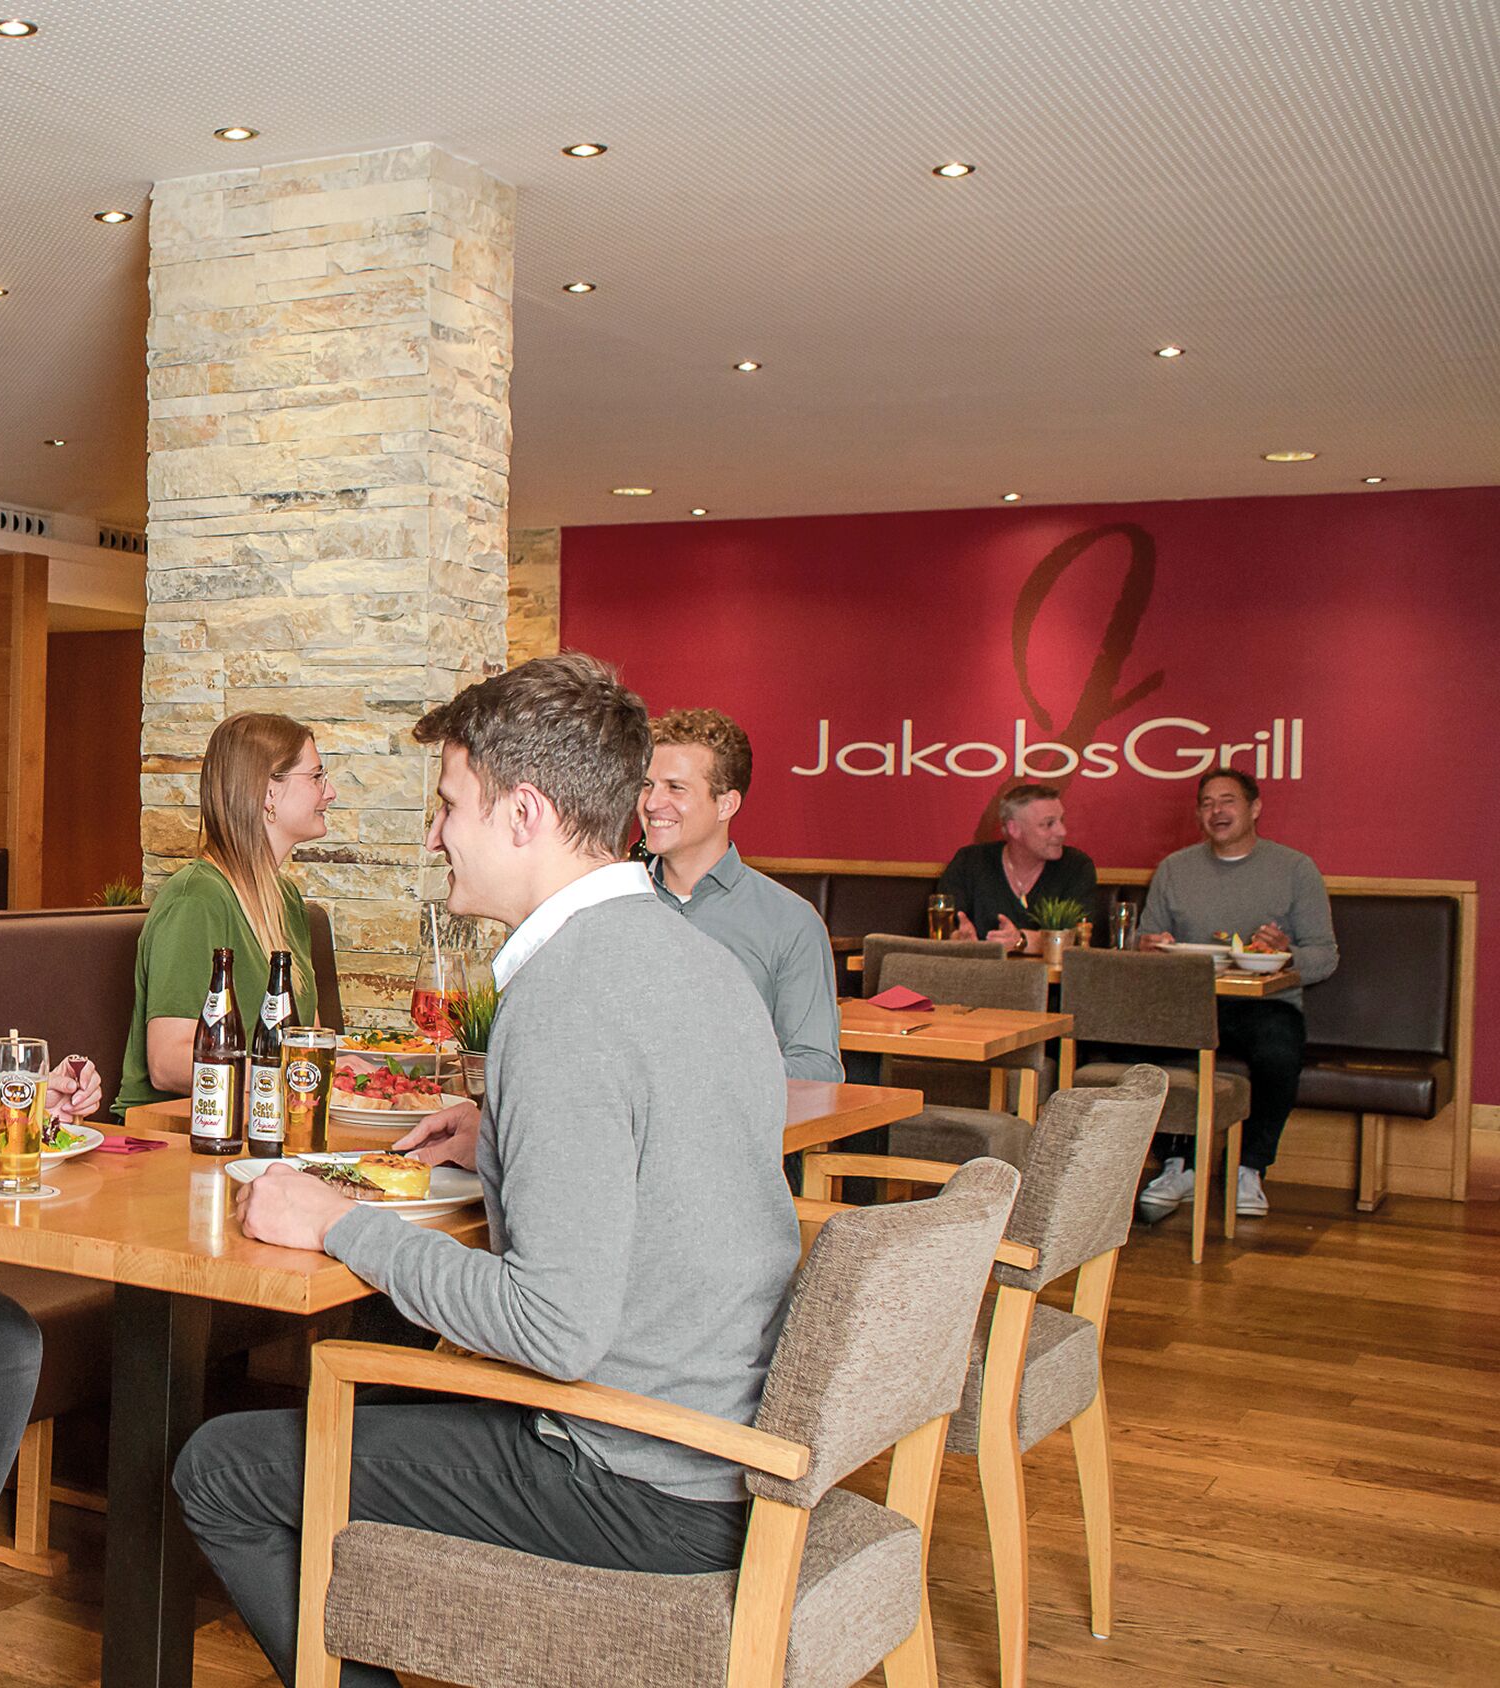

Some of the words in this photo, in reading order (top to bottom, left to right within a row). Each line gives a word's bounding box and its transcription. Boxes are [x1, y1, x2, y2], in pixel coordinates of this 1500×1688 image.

[791, 718, 1303, 780] JakobsGrill
[197, 1098, 216, 1108] Gold
[255, 1101, 274, 1111] Gold
[195, 1105, 223, 1116] Ochsen
